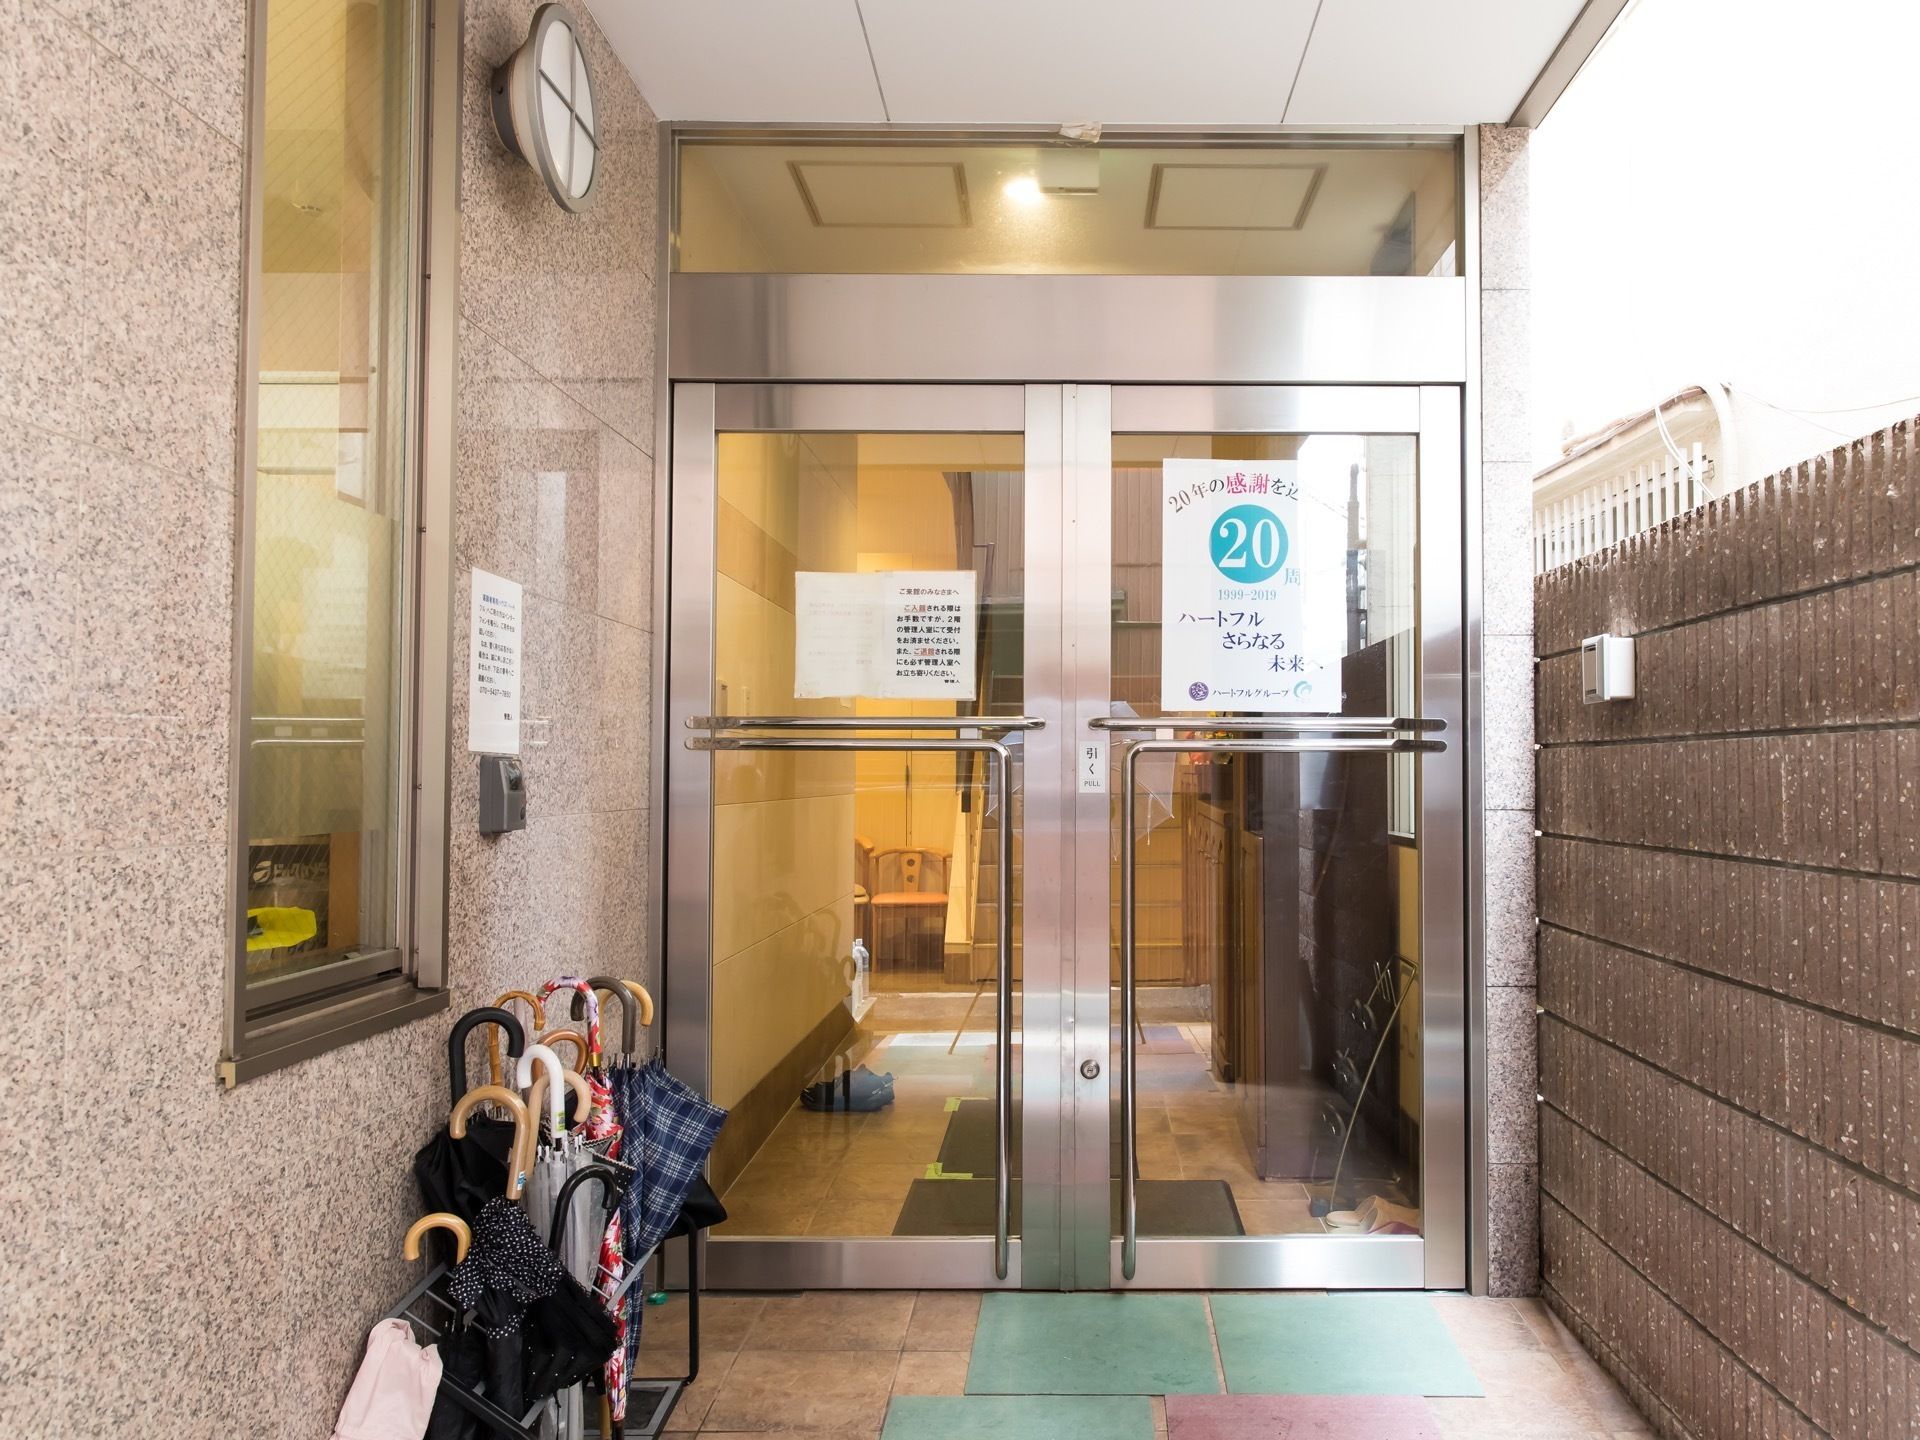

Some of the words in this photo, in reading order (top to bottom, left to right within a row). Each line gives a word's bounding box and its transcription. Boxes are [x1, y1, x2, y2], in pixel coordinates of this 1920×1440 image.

[1218, 518, 1281, 569] 20
[899, 588, 960, 596] ご来館のみなさまへ
[1217, 588, 1277, 601] 1999-2019
[903, 604, 961, 612] ご入館される際は
[1178, 609, 1265, 628] ハートフル
[896, 626, 961, 634] の管理人室にて受付
[1222, 631, 1286, 650] さらなる
[896, 658, 961, 667] にも必ず管理人室へ
[896, 669, 956, 677] お立ち寄りください。
[1212, 688, 1289, 698] ハートフルグループ
[1086, 747, 1098, 775] 引く
